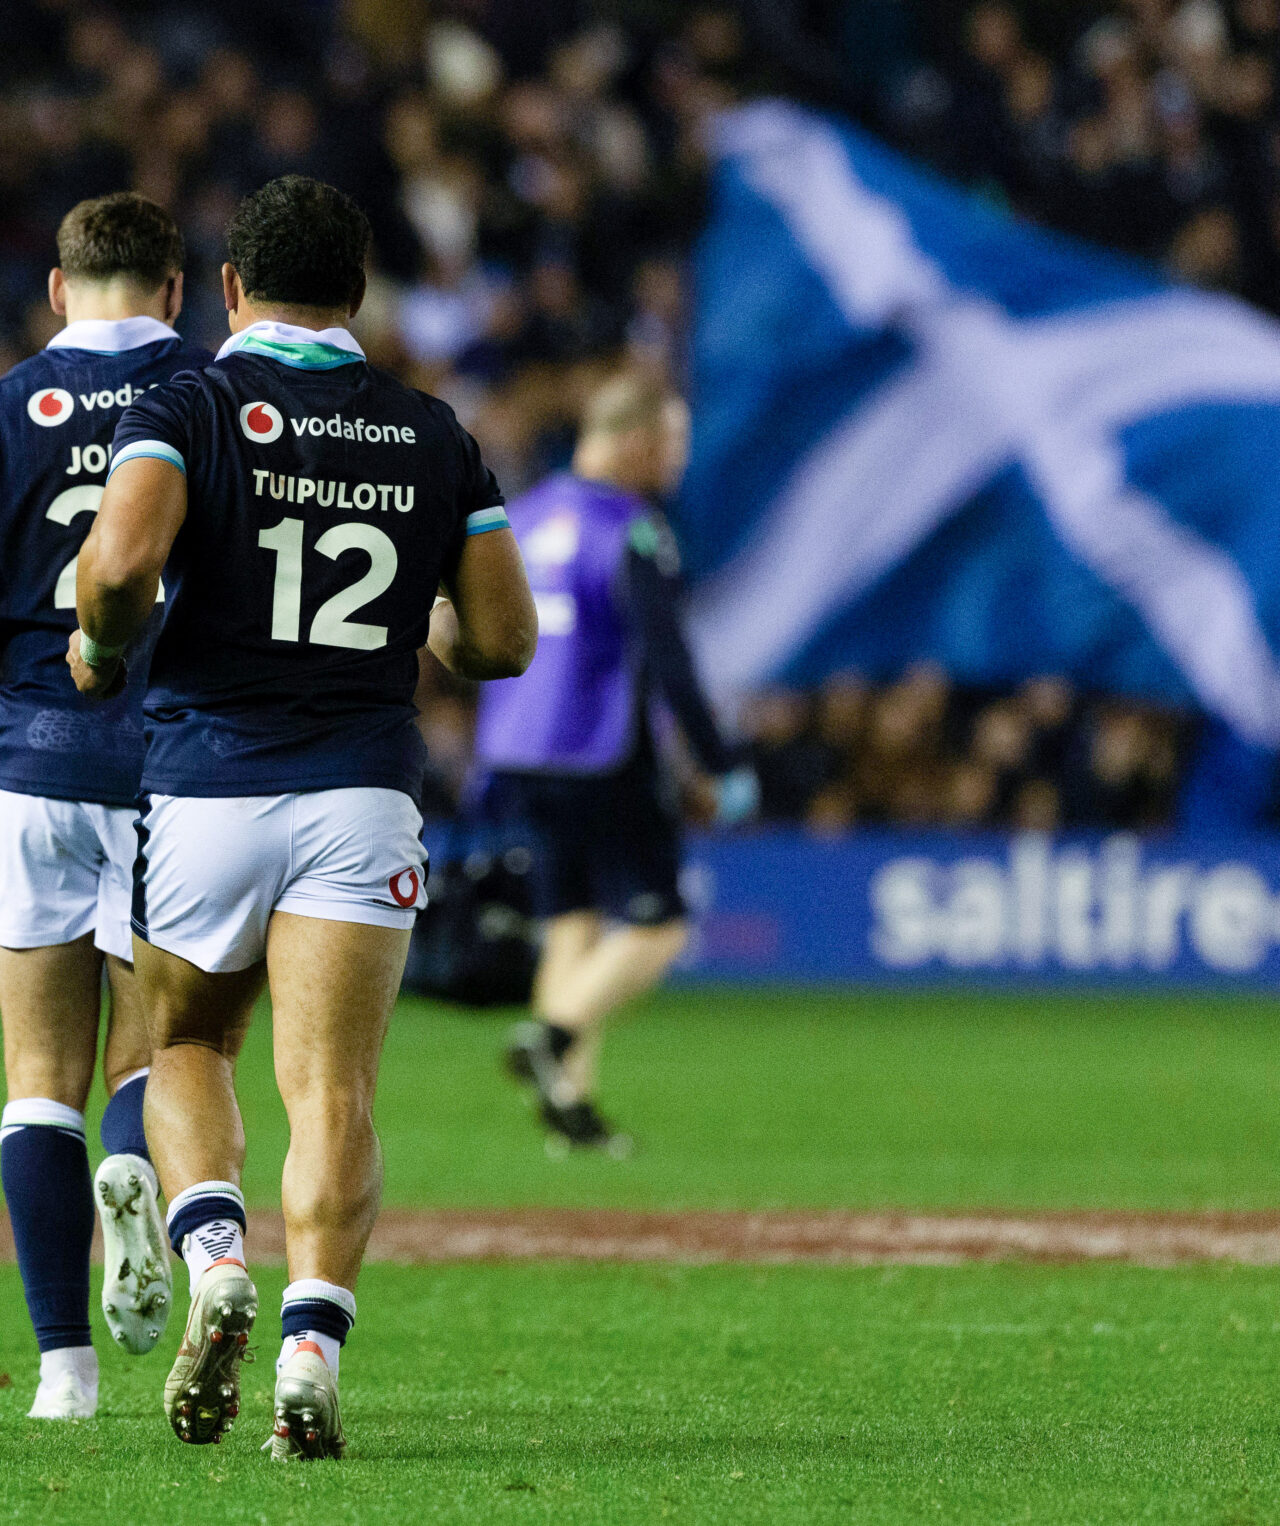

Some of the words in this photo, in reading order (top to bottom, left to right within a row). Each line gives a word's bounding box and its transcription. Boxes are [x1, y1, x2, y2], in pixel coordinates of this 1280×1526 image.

[290, 413, 416, 444] vodafone
[65, 444, 113, 475] JO
[253, 469, 415, 513] TUIPULOTU
[258, 517, 398, 650] 12
